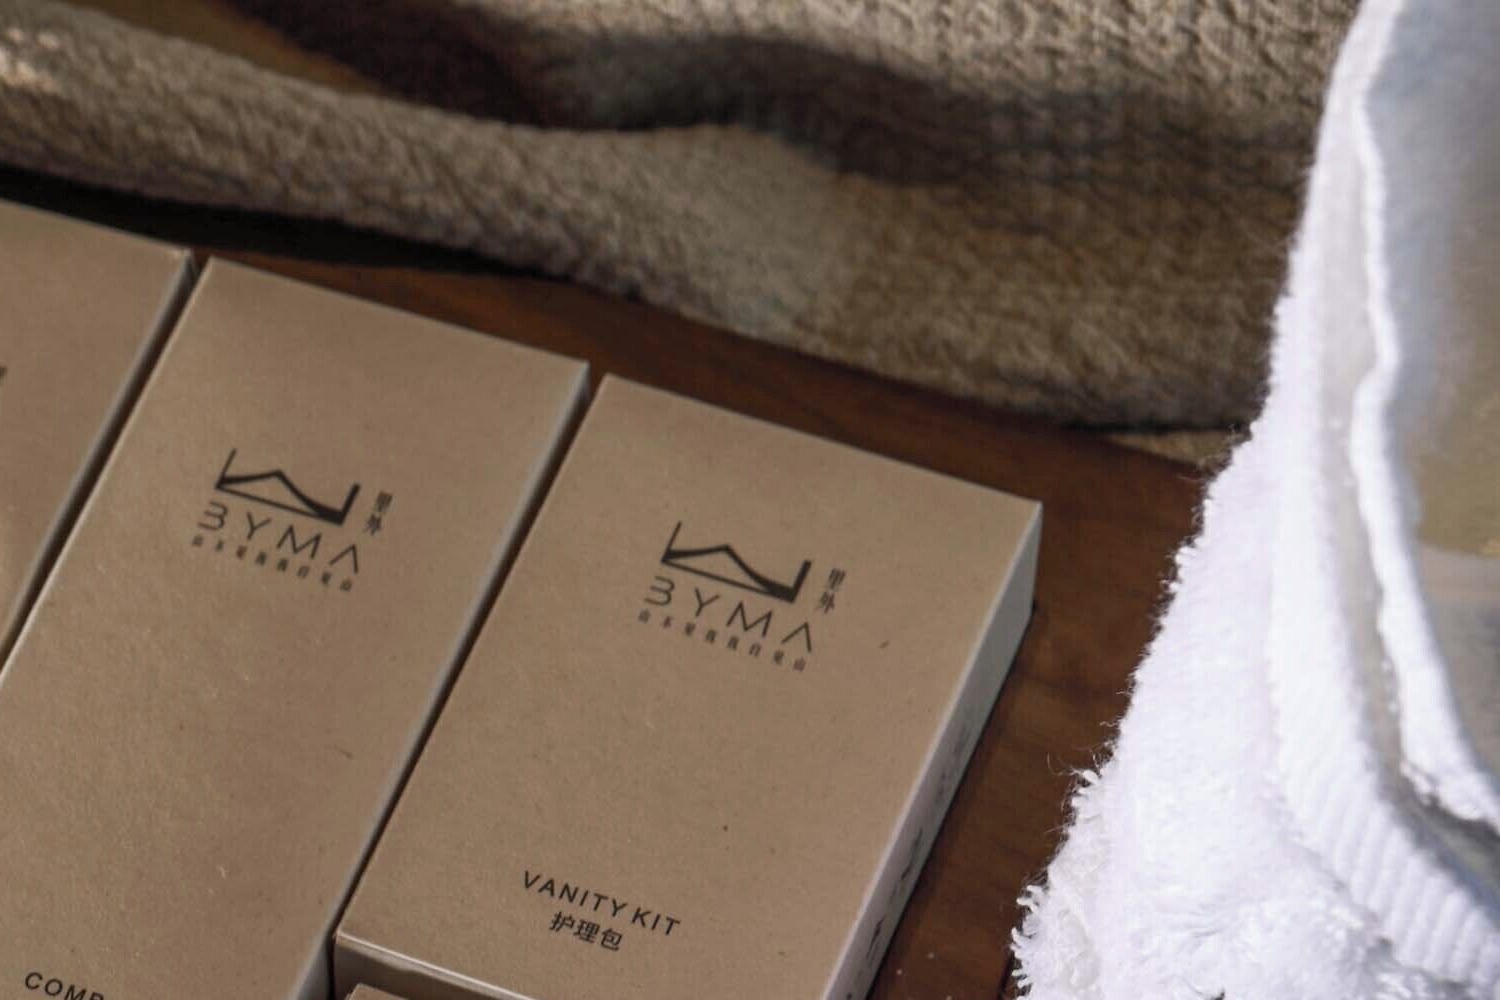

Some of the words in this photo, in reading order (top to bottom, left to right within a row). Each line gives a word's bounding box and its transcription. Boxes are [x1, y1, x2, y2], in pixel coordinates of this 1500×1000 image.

[524, 870, 628, 917] VANITY
[631, 907, 681, 936] KIT
[549, 911, 623, 951] 护理包
